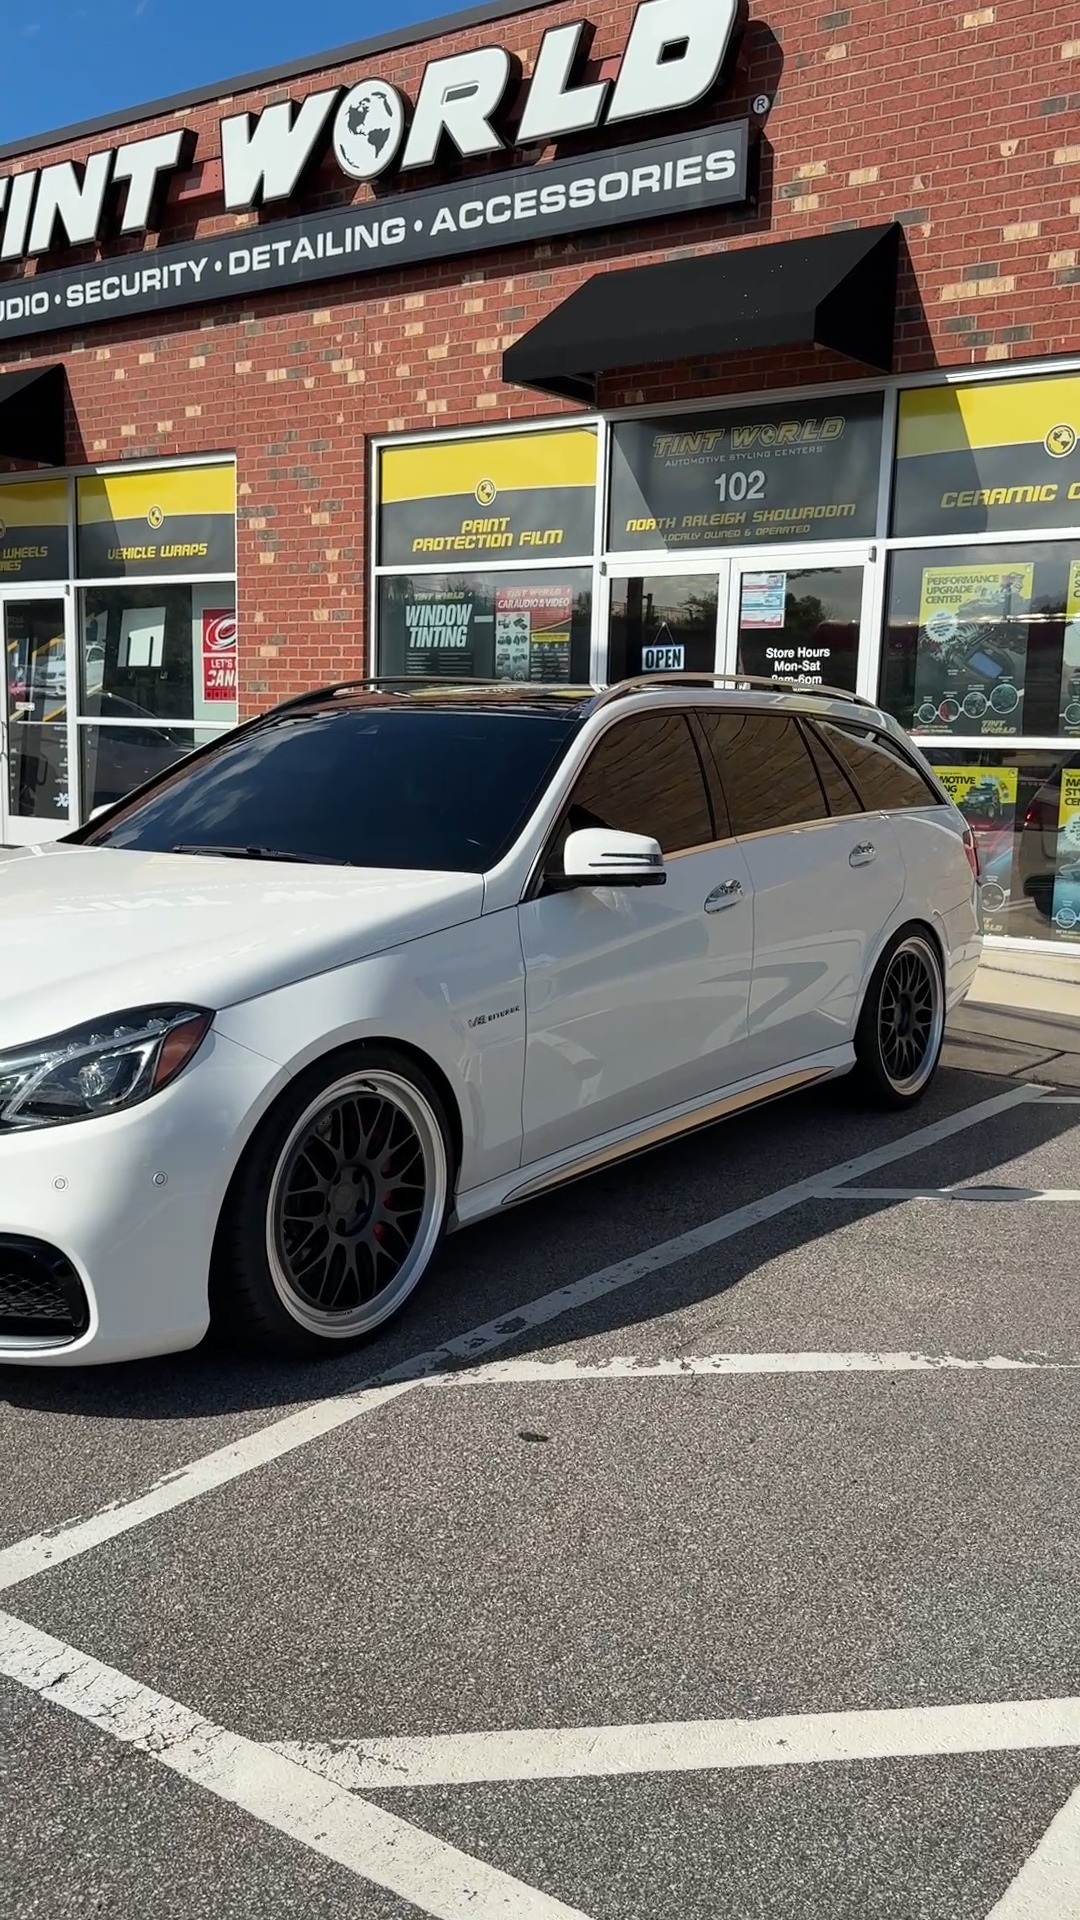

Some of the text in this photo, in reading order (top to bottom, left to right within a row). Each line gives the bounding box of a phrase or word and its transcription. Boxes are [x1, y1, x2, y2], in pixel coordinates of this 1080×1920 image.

[0, 0, 740, 260] INT WORLD
[66, 257, 209, 308] SECURITY
[228, 219, 405, 276] DETAILING
[430, 149, 736, 236] ACCESSORIES
[653, 416, 845, 457] TINT WORLD
[665, 446, 823, 467] AUTOMOTIVE STYLING CENTERS
[715, 470, 765, 502] 102
[940, 484, 1058, 508] CERAMIC
[461, 517, 510, 534] PAINT
[626, 504, 856, 532] NORTH RALEIGH SHOWROOM
[412, 529, 563, 552] PROTECTION FILM
[662, 525, 810, 542] LOCALLY OWNED & OPERATED
[3, 546, 48, 559] WHEELS
[107, 543, 208, 560] VEHICLE WRAPS
[927, 574, 999, 586] PERFORMANCE
[926, 585, 973, 595] UPGRADE
[498, 600, 514, 609] CAR
[514, 599, 538, 608] AUDIO
[545, 598, 570, 607] VIDEO
[925, 595, 962, 604] CENTER
[405, 603, 473, 627] WINDOW
[409, 626, 468, 648] TINTING
[645, 648, 681, 668] OPEN
[766, 647, 830, 658] Store Hours
[774, 660, 821, 671] Mon-Sat
[980, 726, 1016, 734] WORLD
